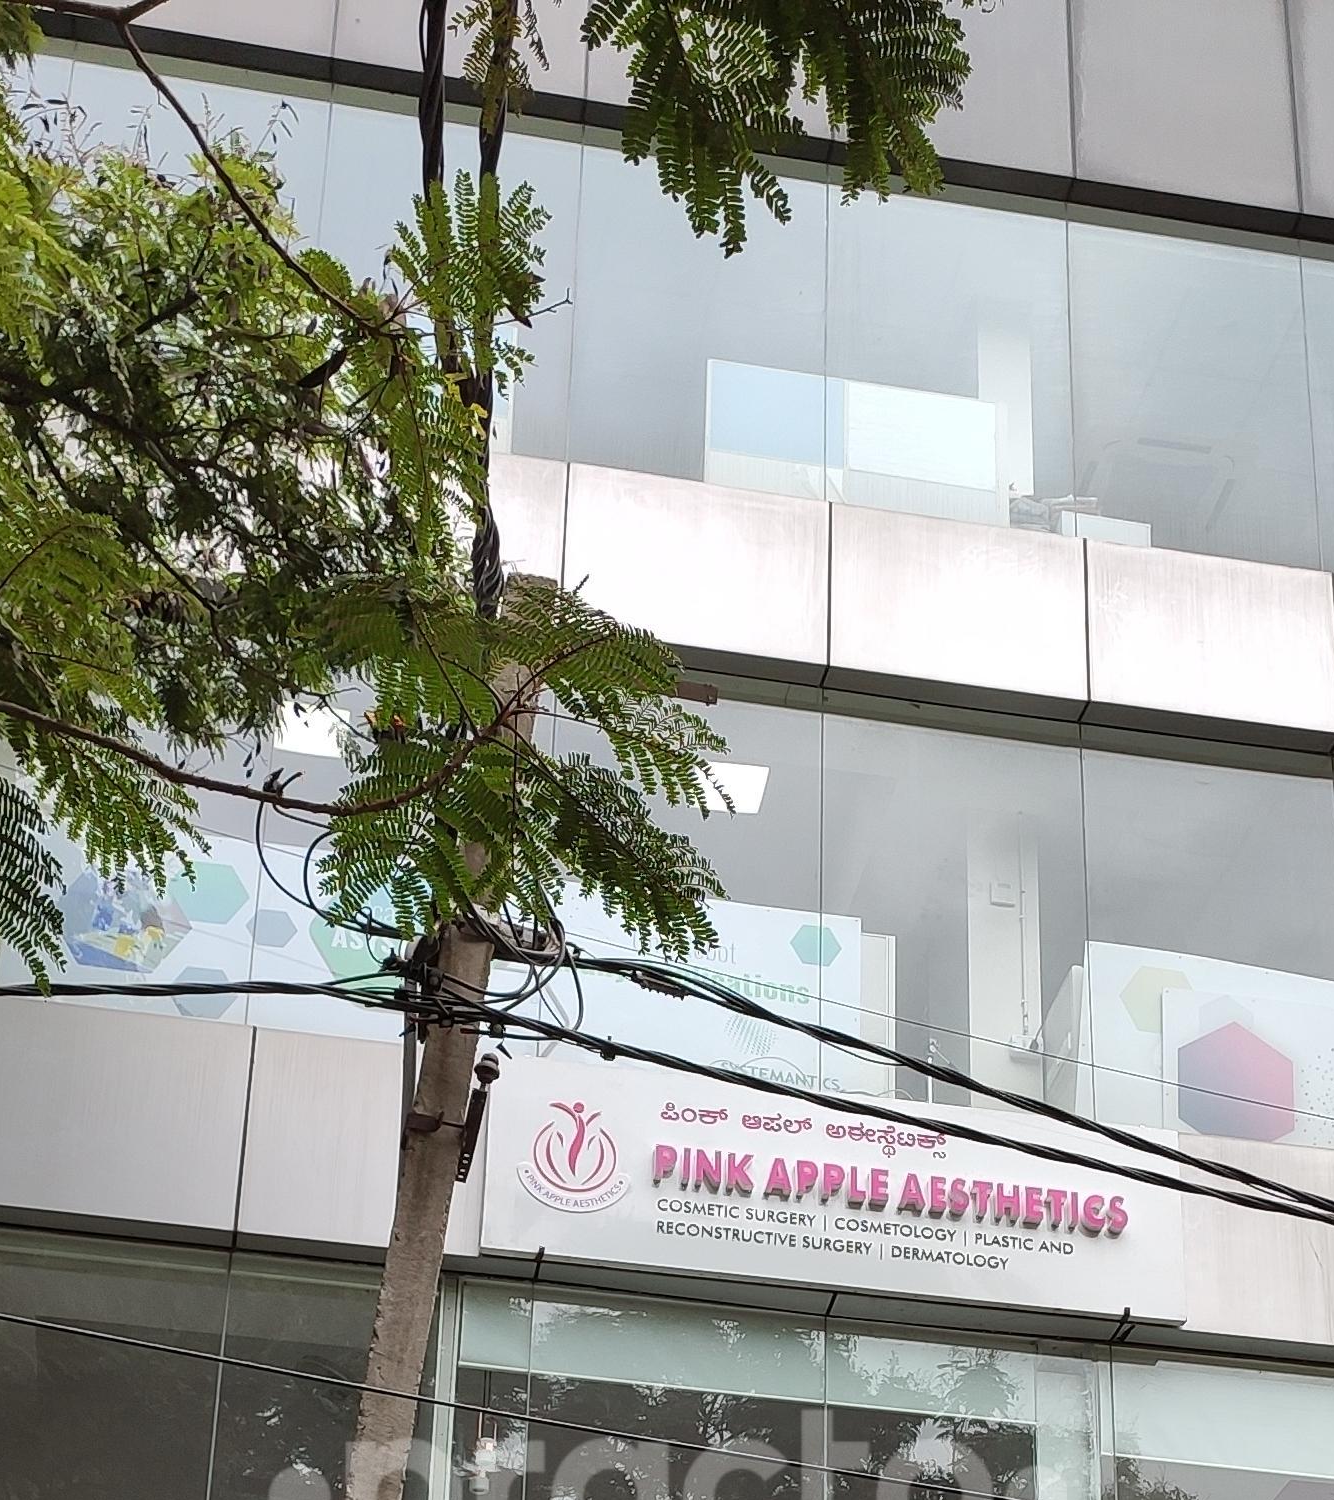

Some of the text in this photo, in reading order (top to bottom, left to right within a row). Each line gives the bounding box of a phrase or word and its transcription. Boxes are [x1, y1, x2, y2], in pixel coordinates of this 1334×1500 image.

[721, 1061, 841, 1091] SYSTEMANTCS
[741, 1112, 813, 1134] ಆಪಲ್
[526, 1173, 622, 1208] PINK APPLE AESTHETICS
[651, 1144, 1128, 1238] PINK APPLE AESTHETICS
[656, 1220, 1010, 1271] RECONSTRUCTIVE SURGERY DERMATOLOGY
[657, 1198, 1075, 1255] COSMETIC SURGERY COSMETOLOGY PLASTIC AND
